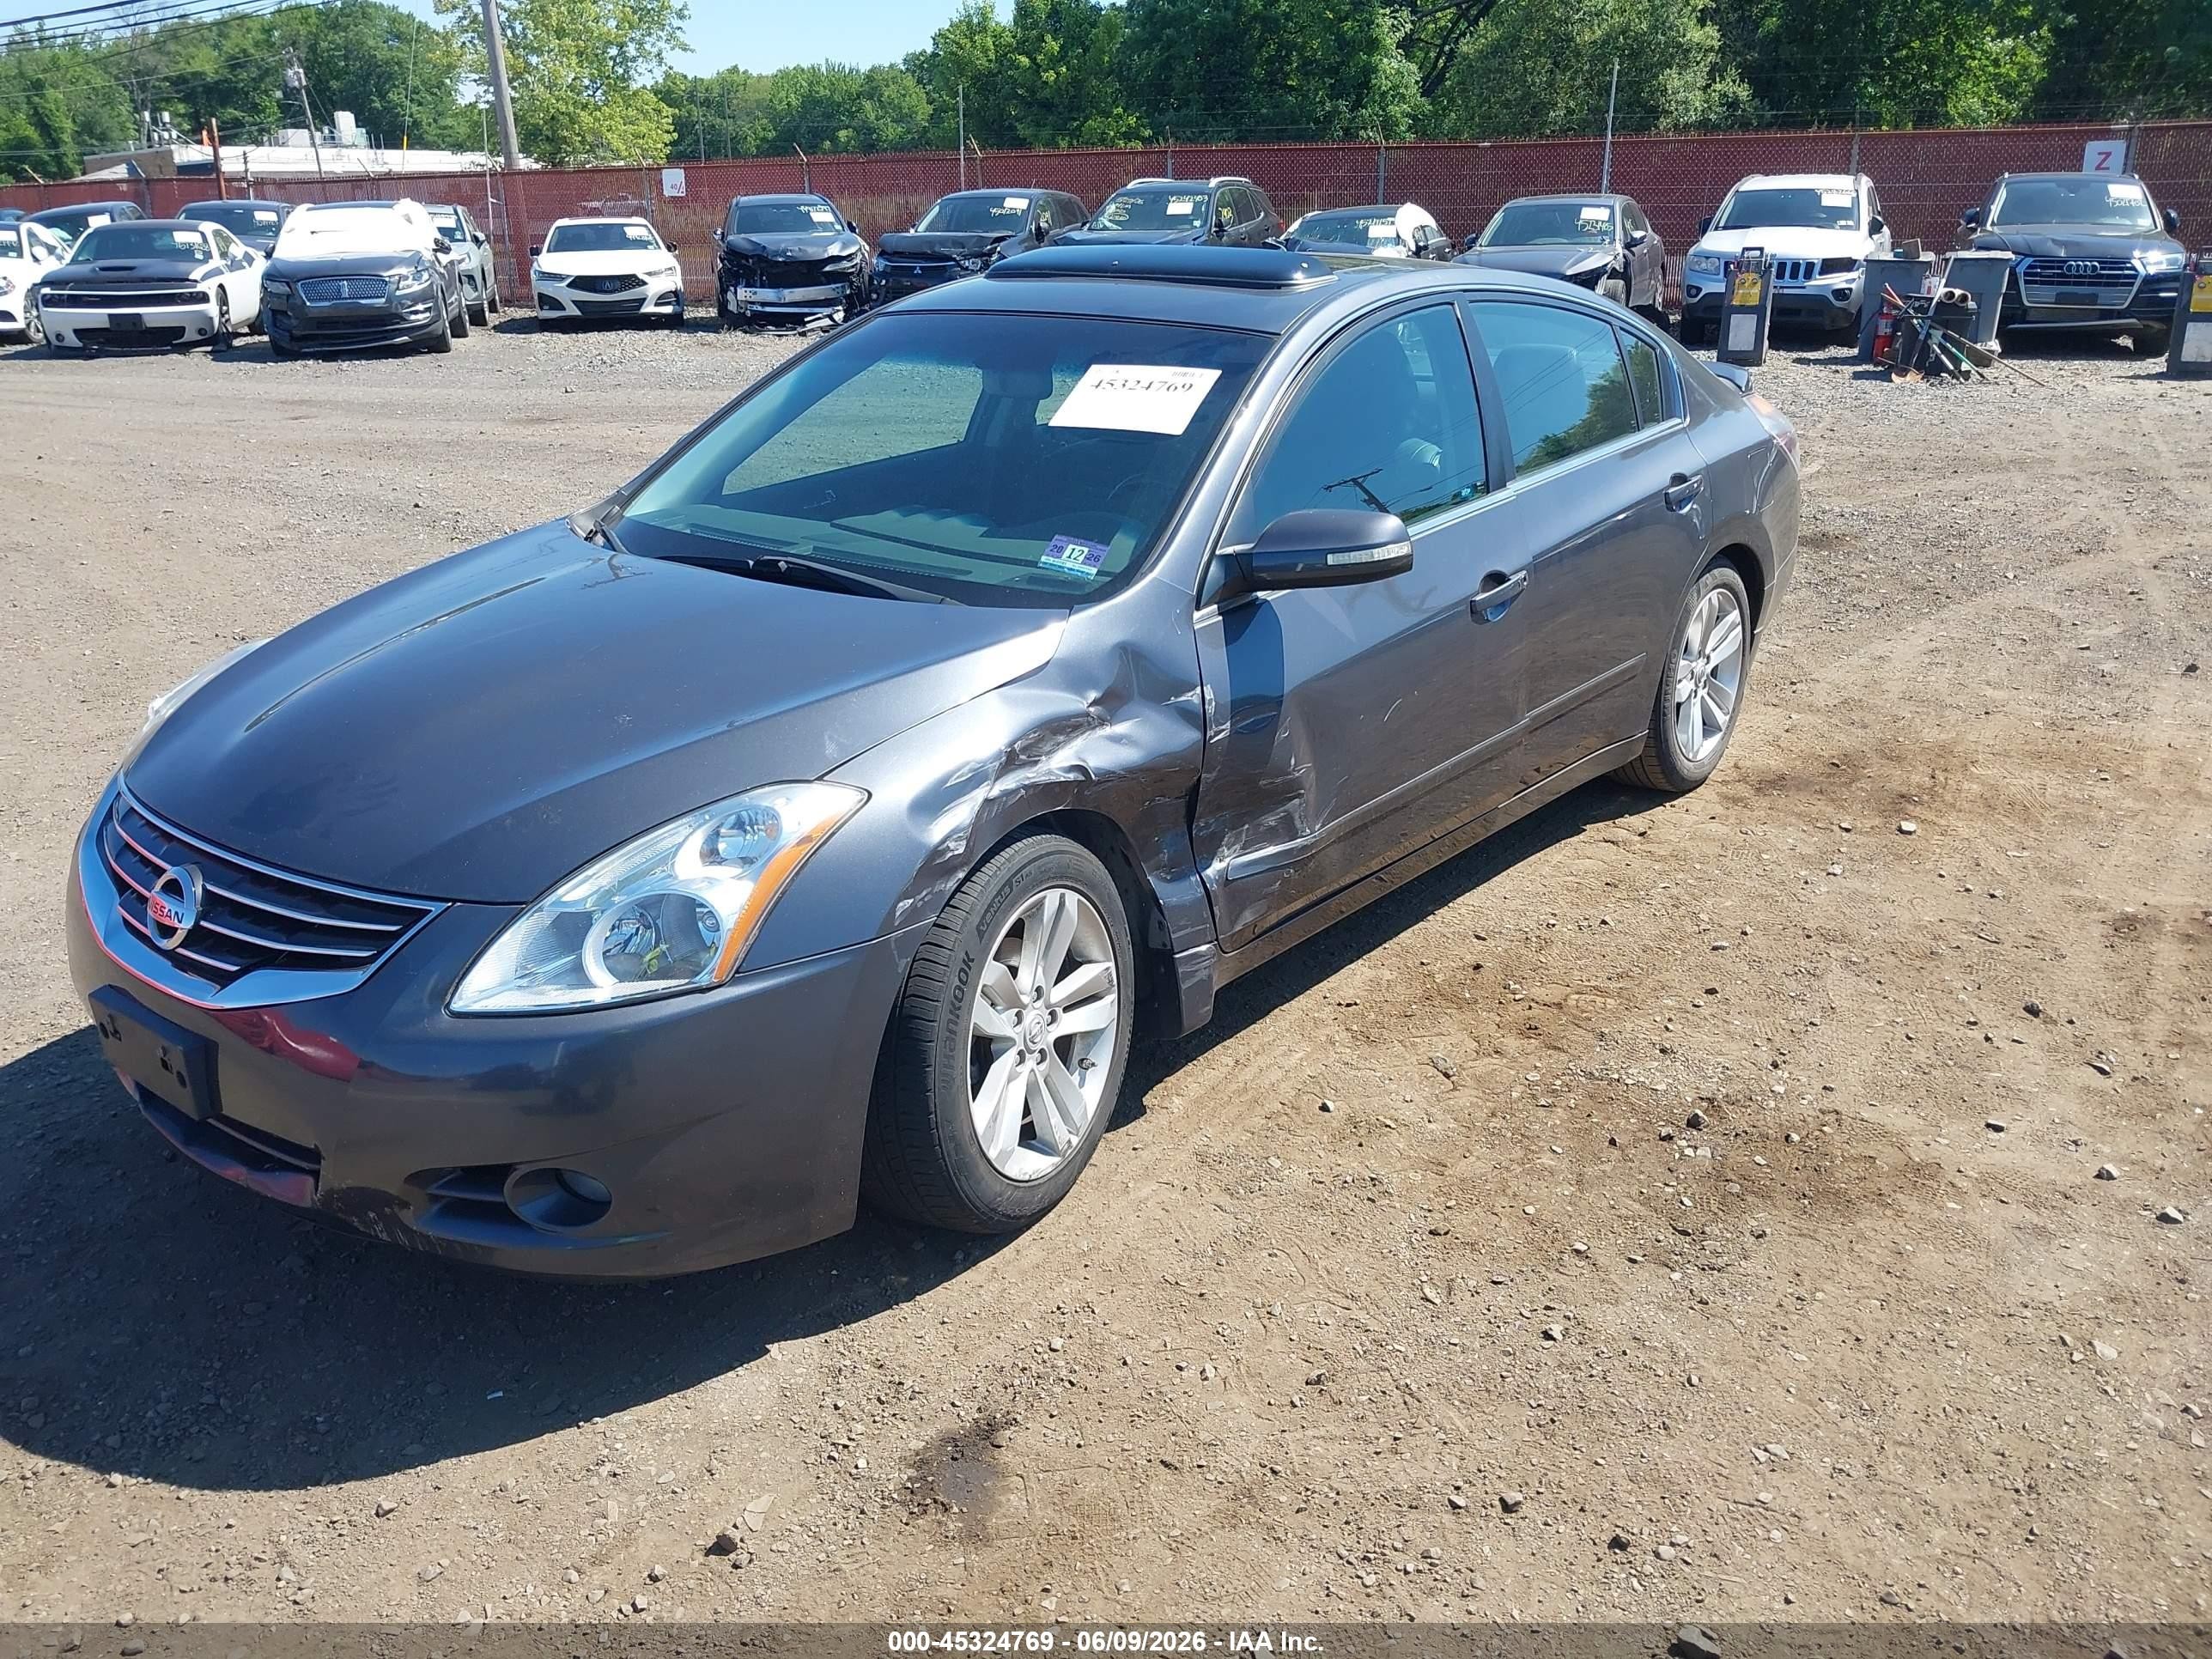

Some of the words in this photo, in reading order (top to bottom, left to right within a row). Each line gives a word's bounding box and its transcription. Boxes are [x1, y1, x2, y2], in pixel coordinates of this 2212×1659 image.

[2094, 150, 2112, 171] Z
[1091, 379, 1194, 392] 45324769
[1049, 544, 1064, 554] 20
[1066, 547, 1085, 562] 12
[1086, 552, 1102, 562] 26
